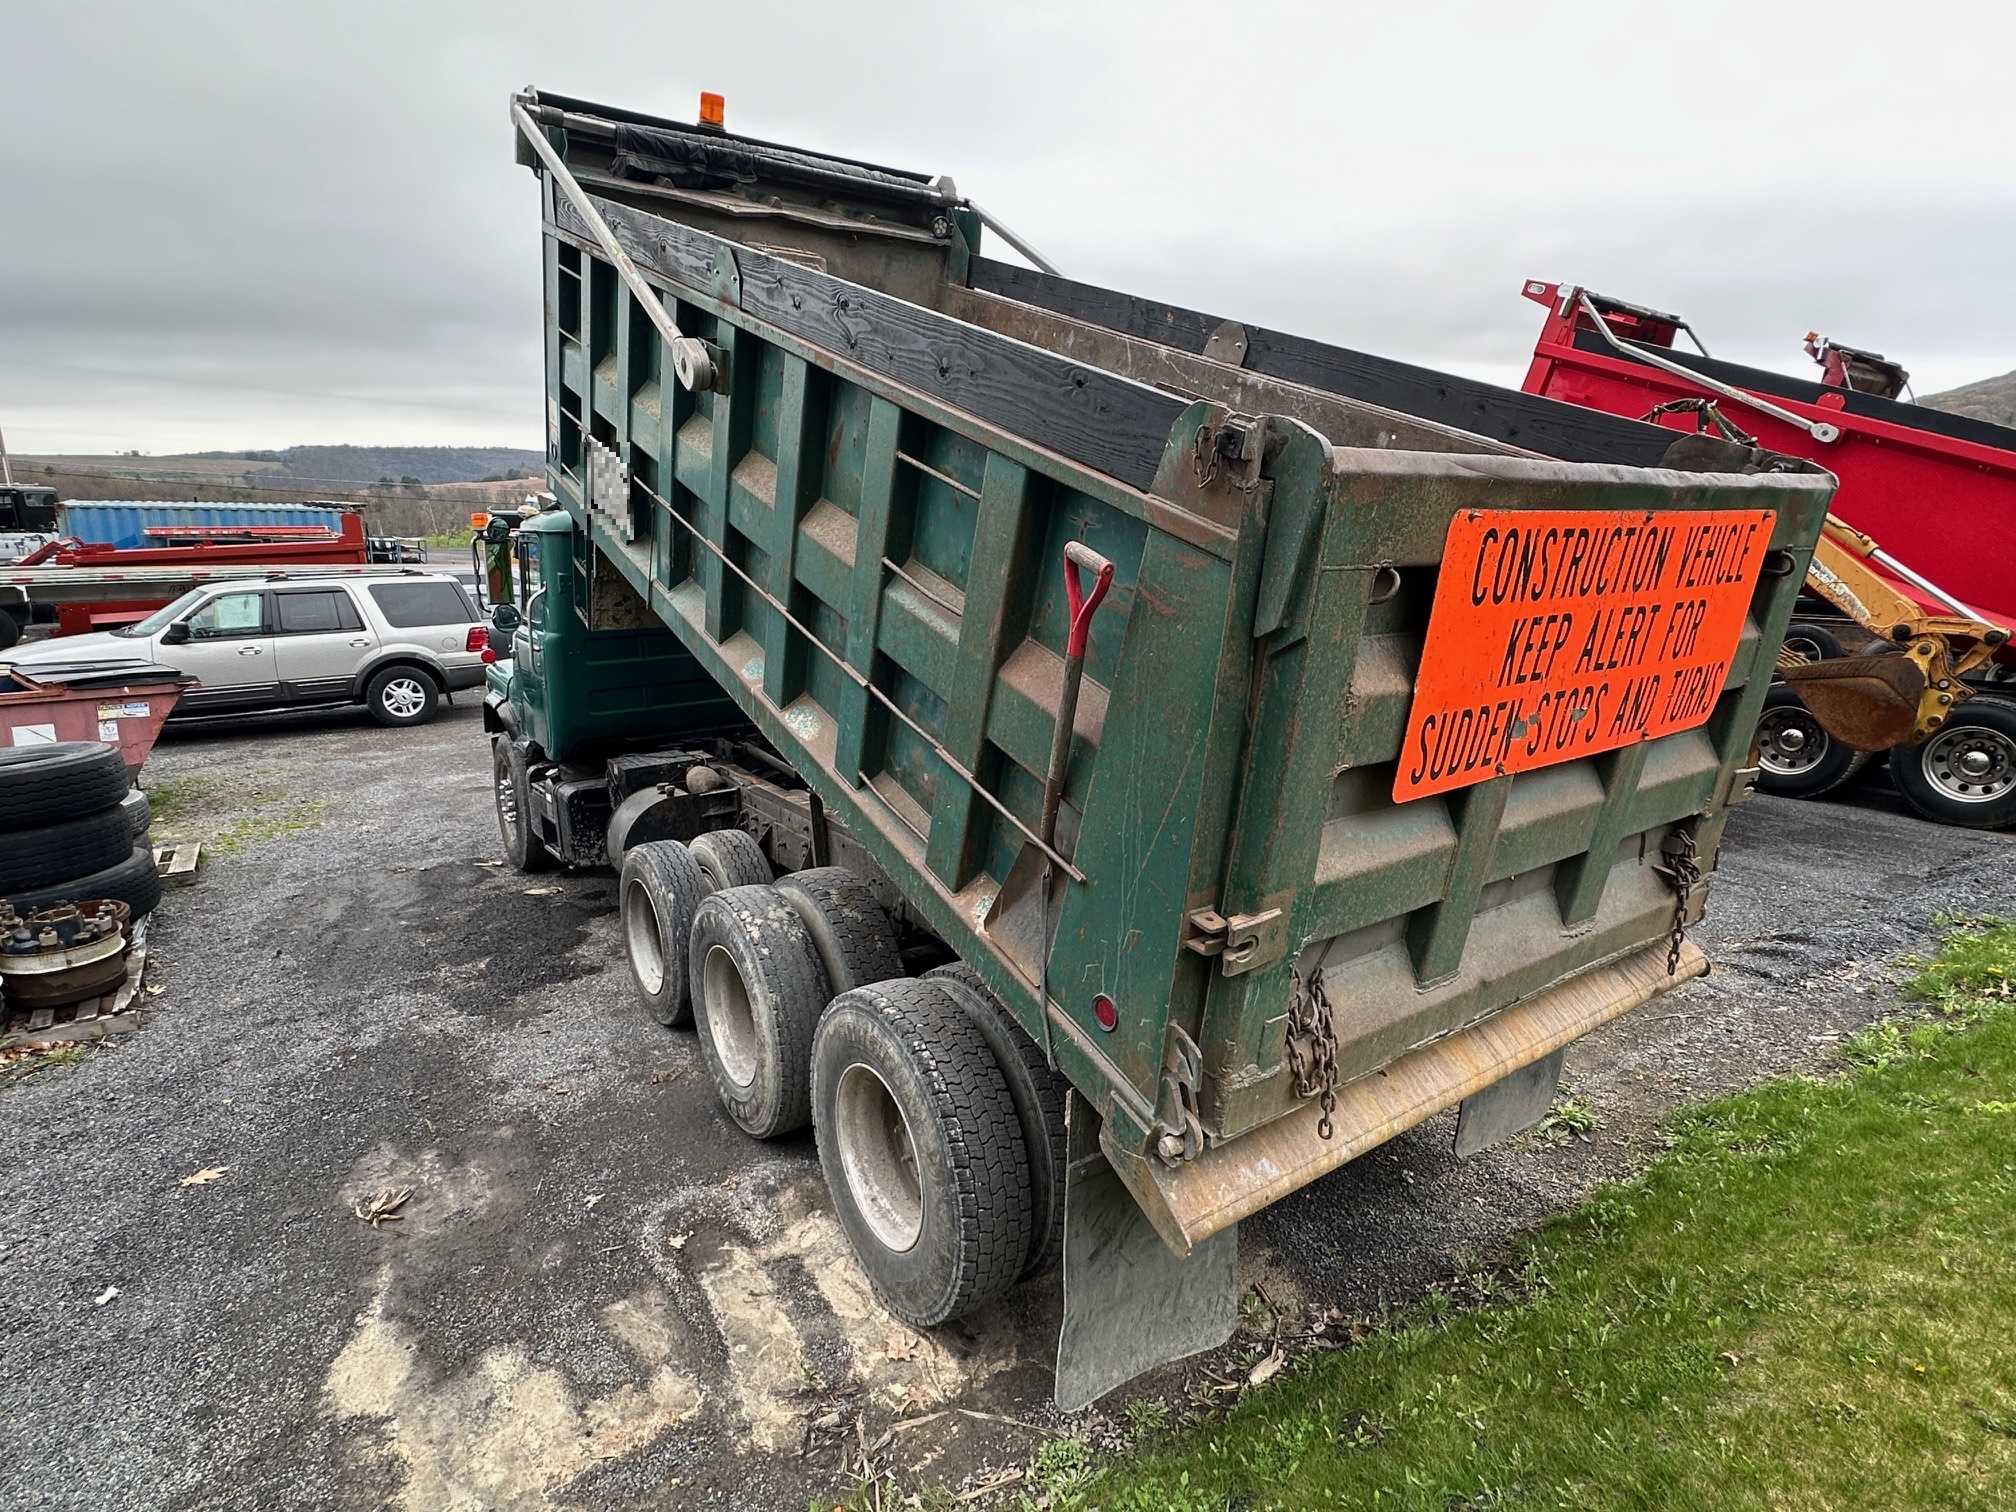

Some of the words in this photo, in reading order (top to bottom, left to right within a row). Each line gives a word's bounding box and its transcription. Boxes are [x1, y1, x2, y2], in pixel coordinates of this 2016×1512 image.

[1472, 527, 1675, 606] CONSTRUCTION
[1676, 524, 1757, 589] VEHICLE
[1497, 613, 1573, 688] KEEP
[1574, 604, 1661, 674] ALERT
[1658, 599, 1707, 662] FOR
[1411, 698, 1525, 785] SUDDEN
[1527, 682, 1609, 757] STOPS
[1608, 674, 1661, 738] AND
[1660, 661, 1725, 726] TURNS
